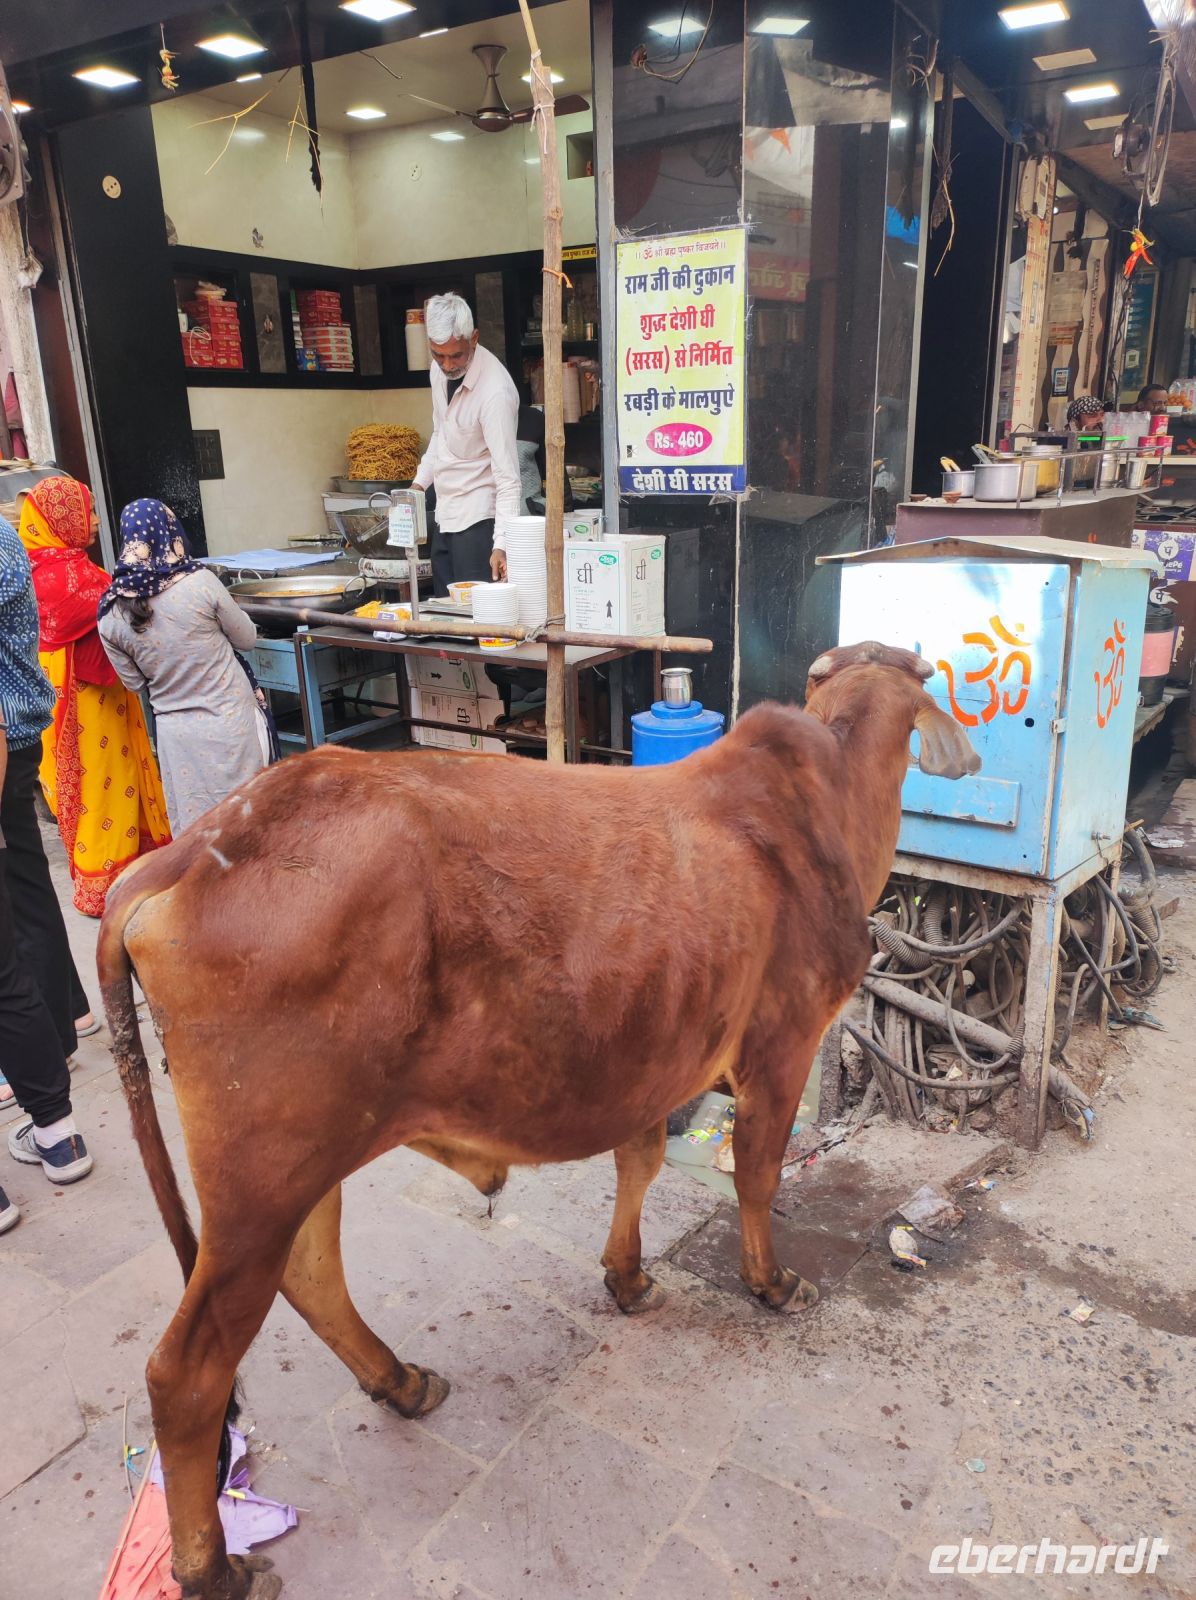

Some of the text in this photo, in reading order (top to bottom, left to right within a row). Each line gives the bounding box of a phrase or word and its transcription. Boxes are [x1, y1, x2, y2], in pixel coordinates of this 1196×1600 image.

[624, 274, 649, 295] राम
[650, 266, 670, 291] जी
[672, 264, 692, 290] की
[693, 264, 736, 296] दुकान
[640, 303, 716, 341] शुद्ध देशी घी
[625, 340, 734, 376] (सरस) से निर्मित
[623, 387, 659, 416] रबड़ी
[661, 385, 676, 410] के
[653, 430, 704, 449] Rs. 460
[631, 468, 733, 491] देशी घी सरस
[576, 562, 594, 584] घी
[635, 558, 647, 581] घी
